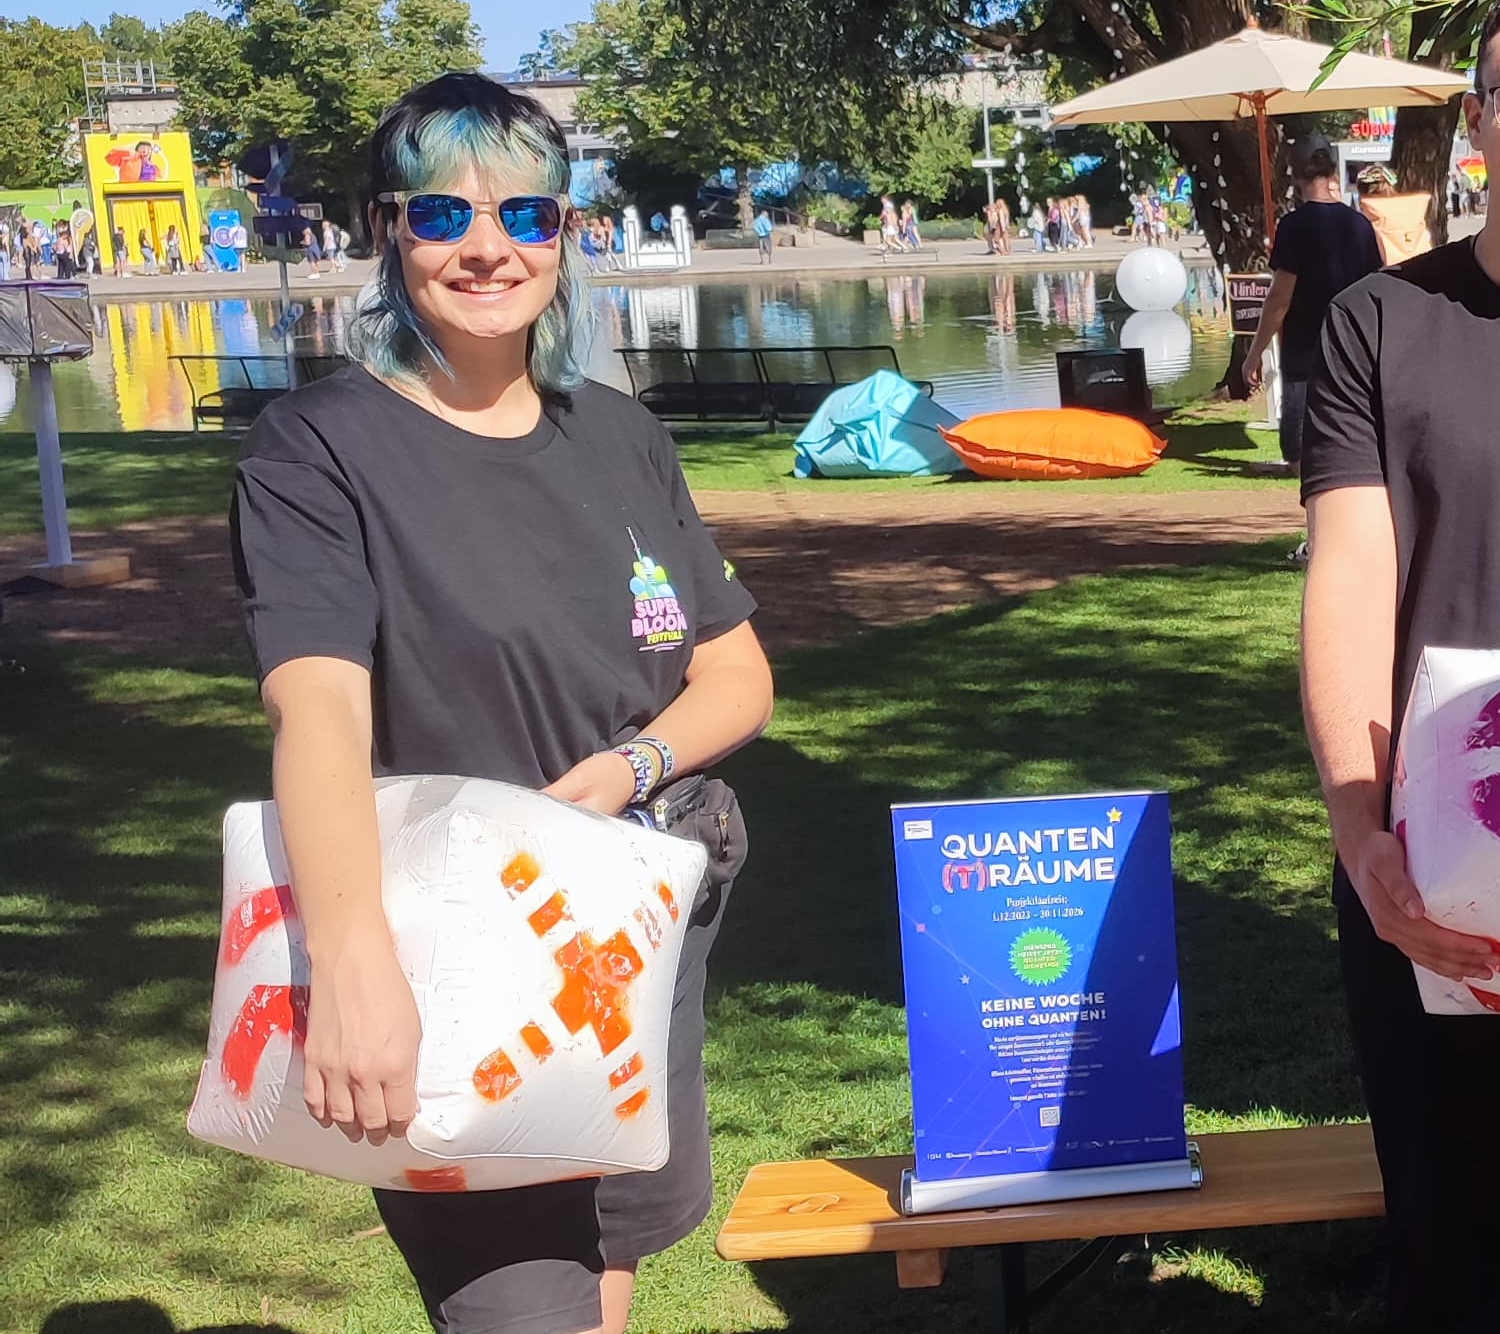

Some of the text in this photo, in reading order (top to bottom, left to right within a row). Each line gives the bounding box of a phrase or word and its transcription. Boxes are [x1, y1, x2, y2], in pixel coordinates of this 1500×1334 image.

[940, 825, 1115, 860] QUANTEN
[981, 992, 1105, 1013] KEINE WOCHE
[981, 1009, 1106, 1029] OHNE QUANTEN!
